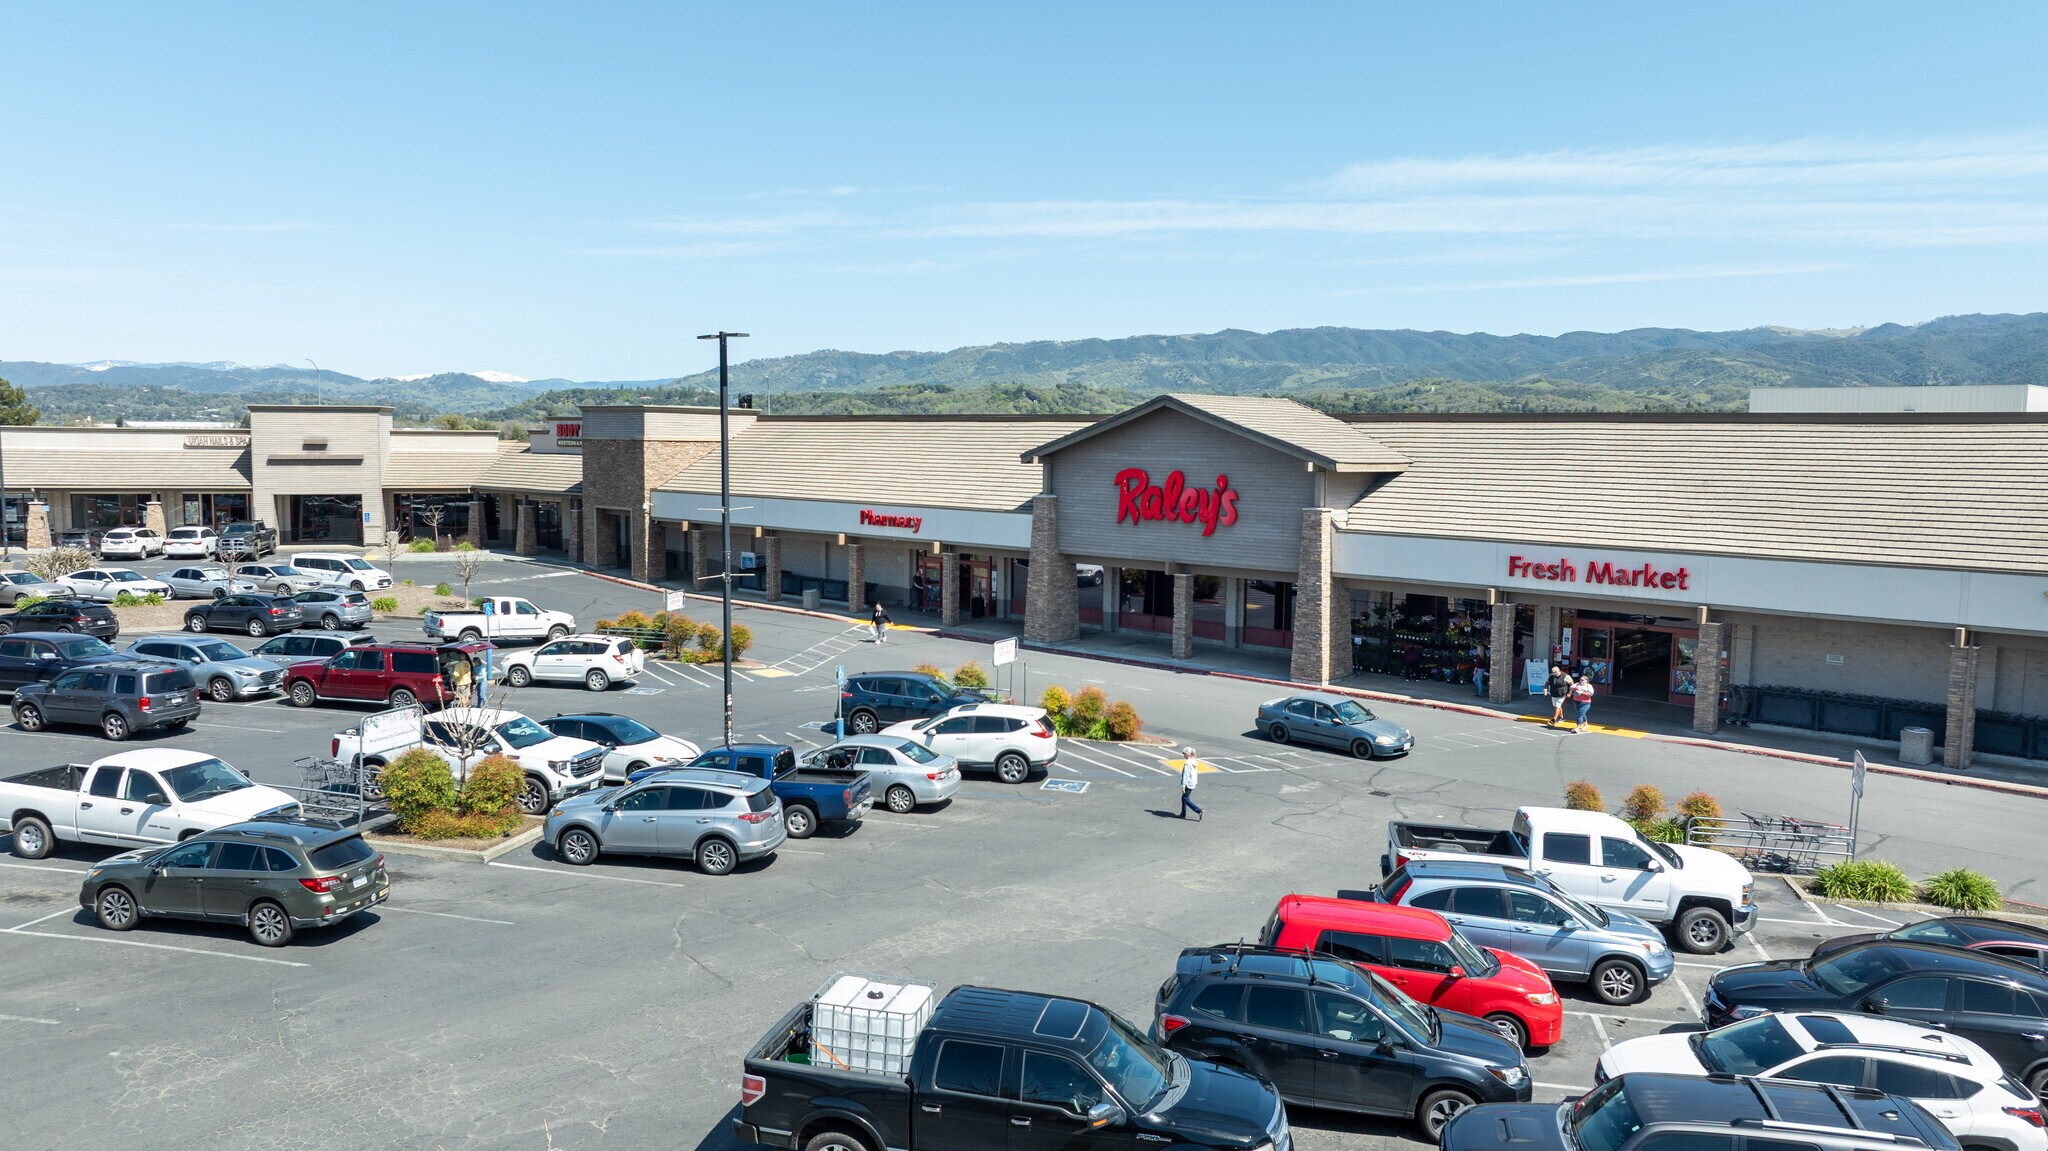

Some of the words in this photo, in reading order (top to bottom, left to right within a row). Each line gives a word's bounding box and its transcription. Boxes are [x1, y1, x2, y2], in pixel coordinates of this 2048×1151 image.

[209, 436, 228, 446] NAILS
[235, 436, 247, 446] SPA
[557, 424, 580, 437] BOOT
[1114, 467, 1239, 537] Raley's
[860, 509, 922, 534] Pharmacy
[1508, 554, 1577, 582] Fresh
[1585, 561, 1691, 591] Market
